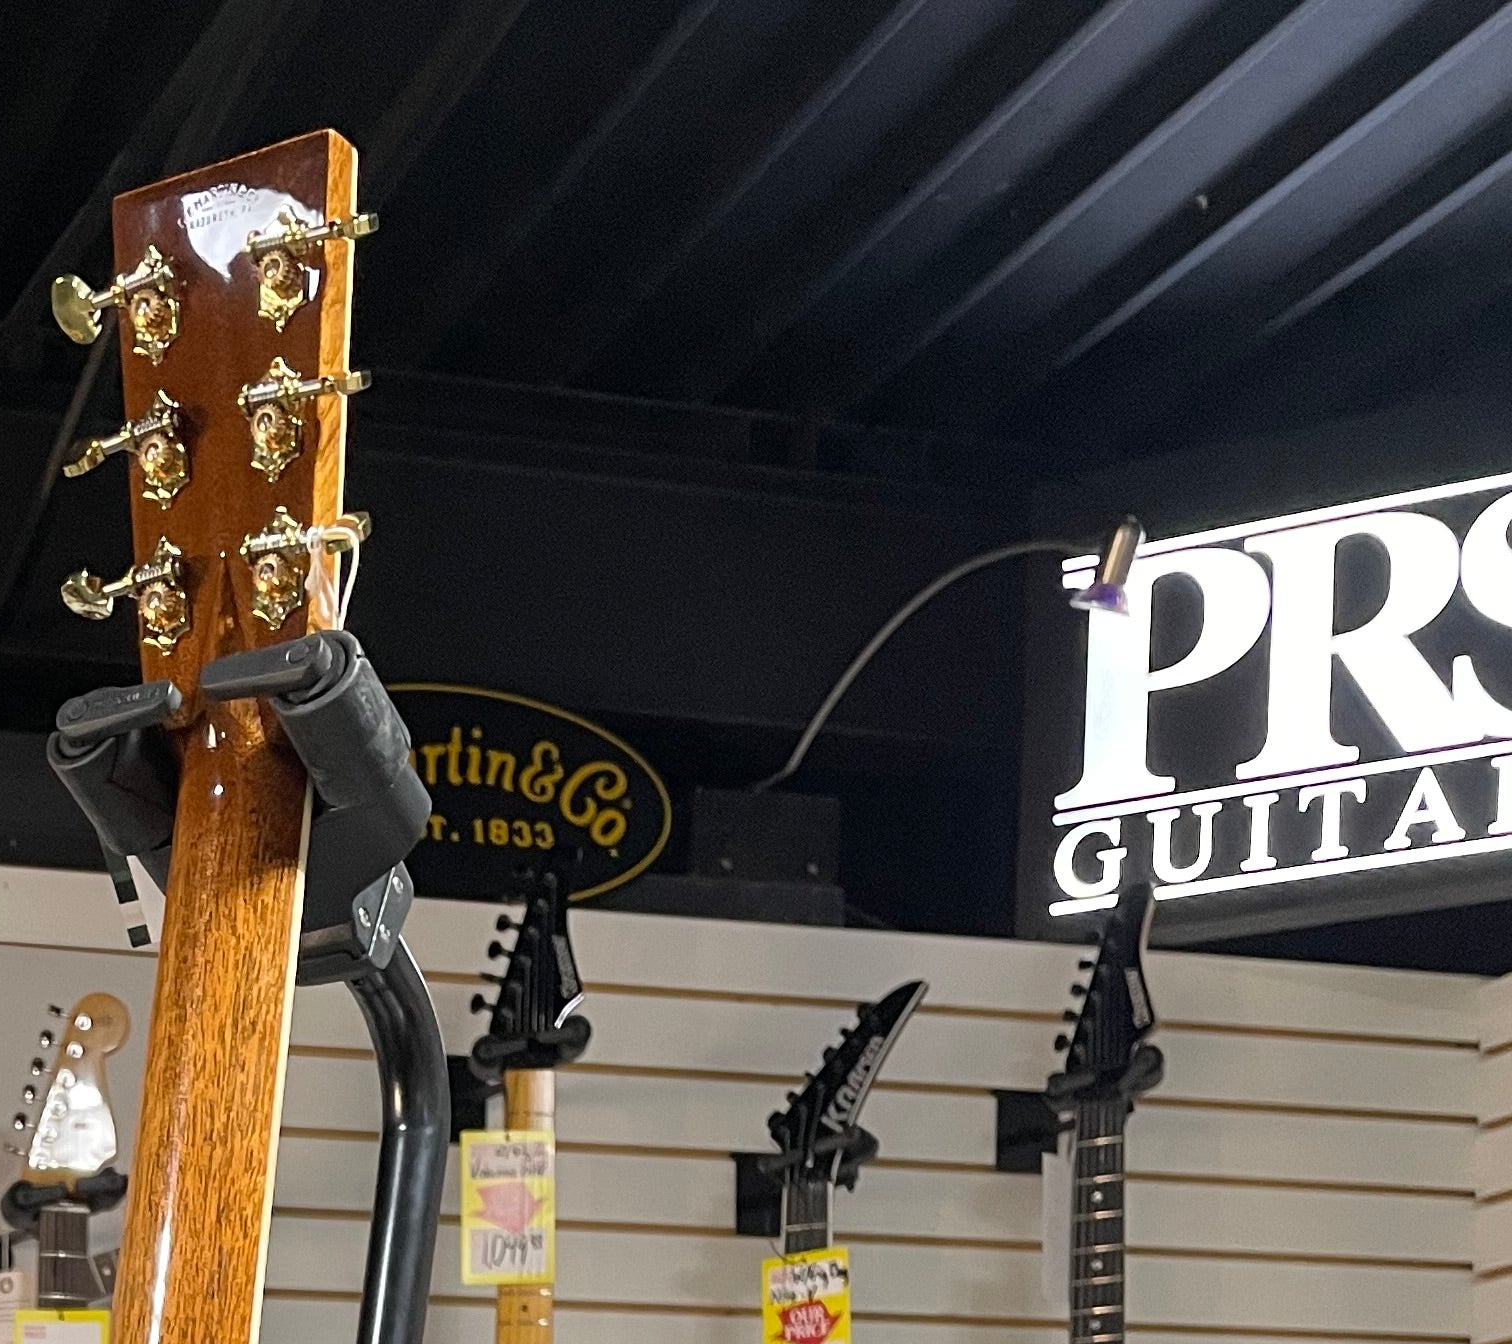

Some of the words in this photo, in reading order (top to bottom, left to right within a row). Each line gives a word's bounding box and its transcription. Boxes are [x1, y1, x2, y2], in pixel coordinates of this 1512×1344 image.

[472, 819, 555, 850] 1833
[1053, 757, 1512, 899] GUITA
[790, 1304, 825, 1324] OUR
[785, 1320, 831, 1341] PRICE
